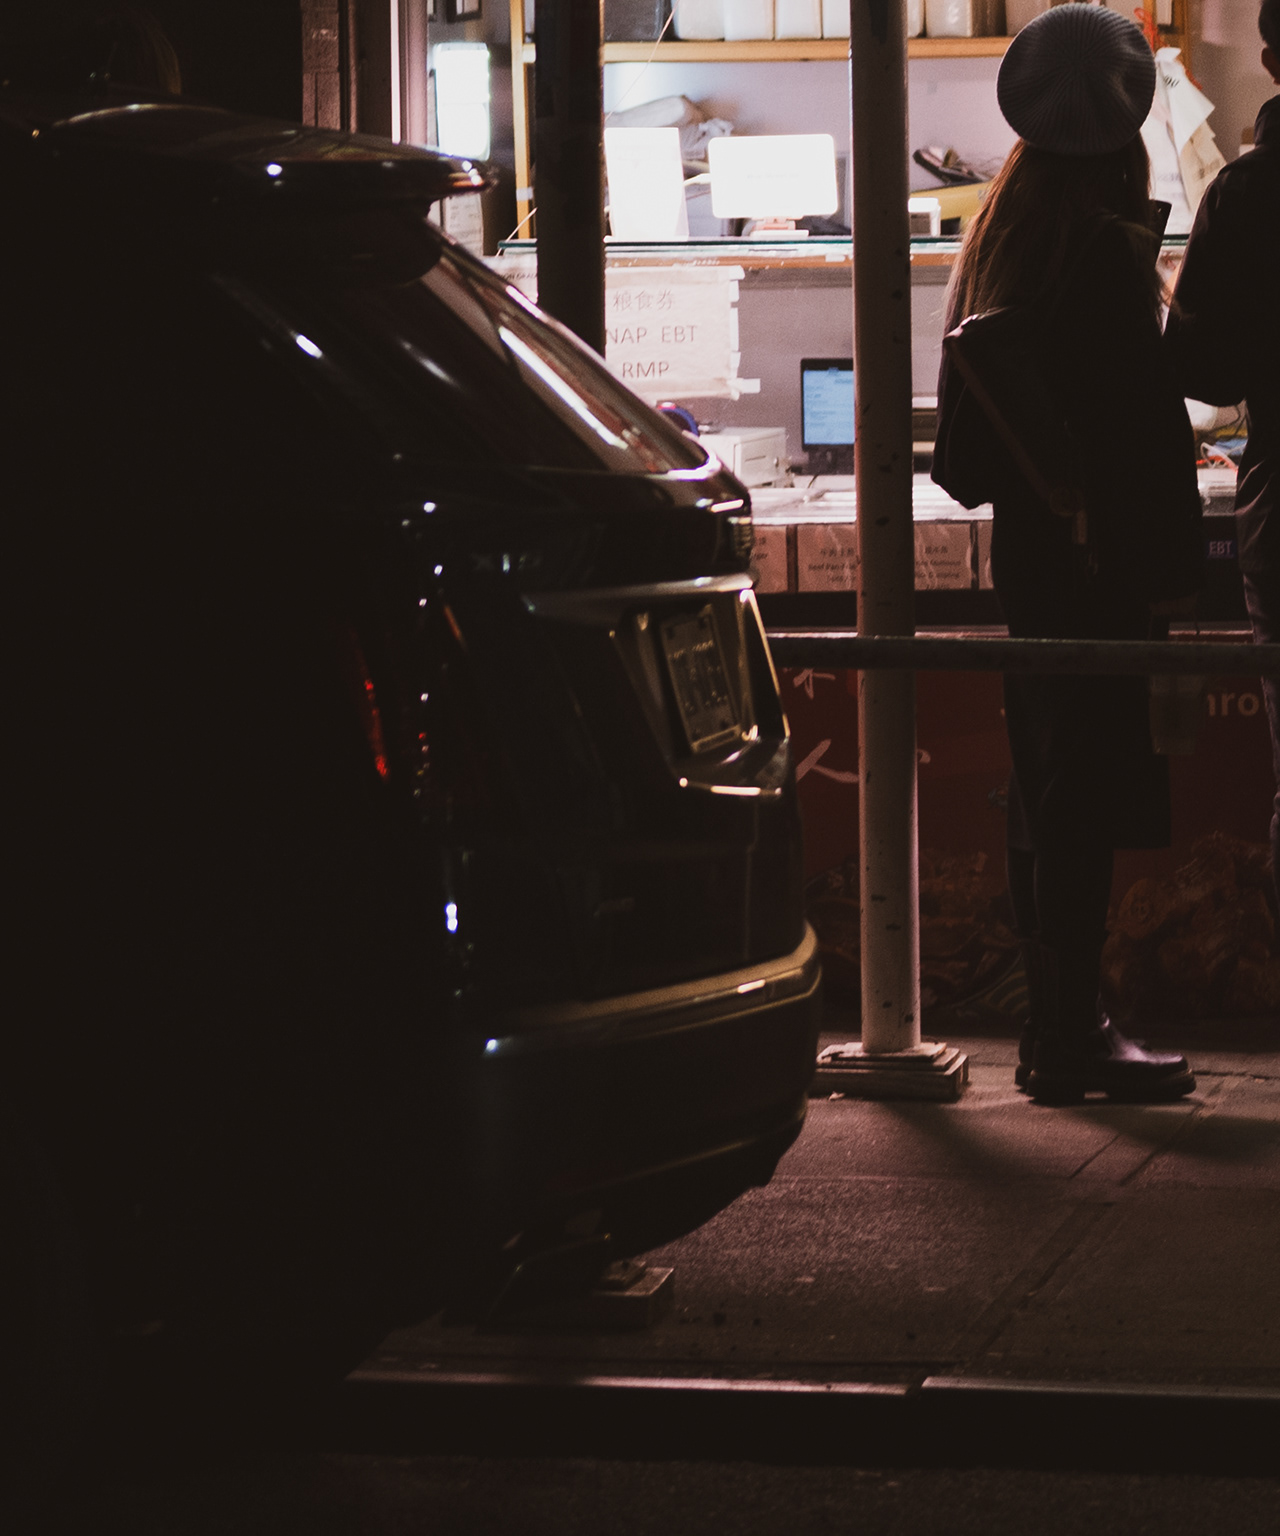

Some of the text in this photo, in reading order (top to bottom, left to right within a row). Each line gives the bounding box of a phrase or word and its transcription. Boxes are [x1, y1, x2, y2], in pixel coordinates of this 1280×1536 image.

[605, 324, 698, 344] NAP EBT
[621, 361, 670, 379] RMP
